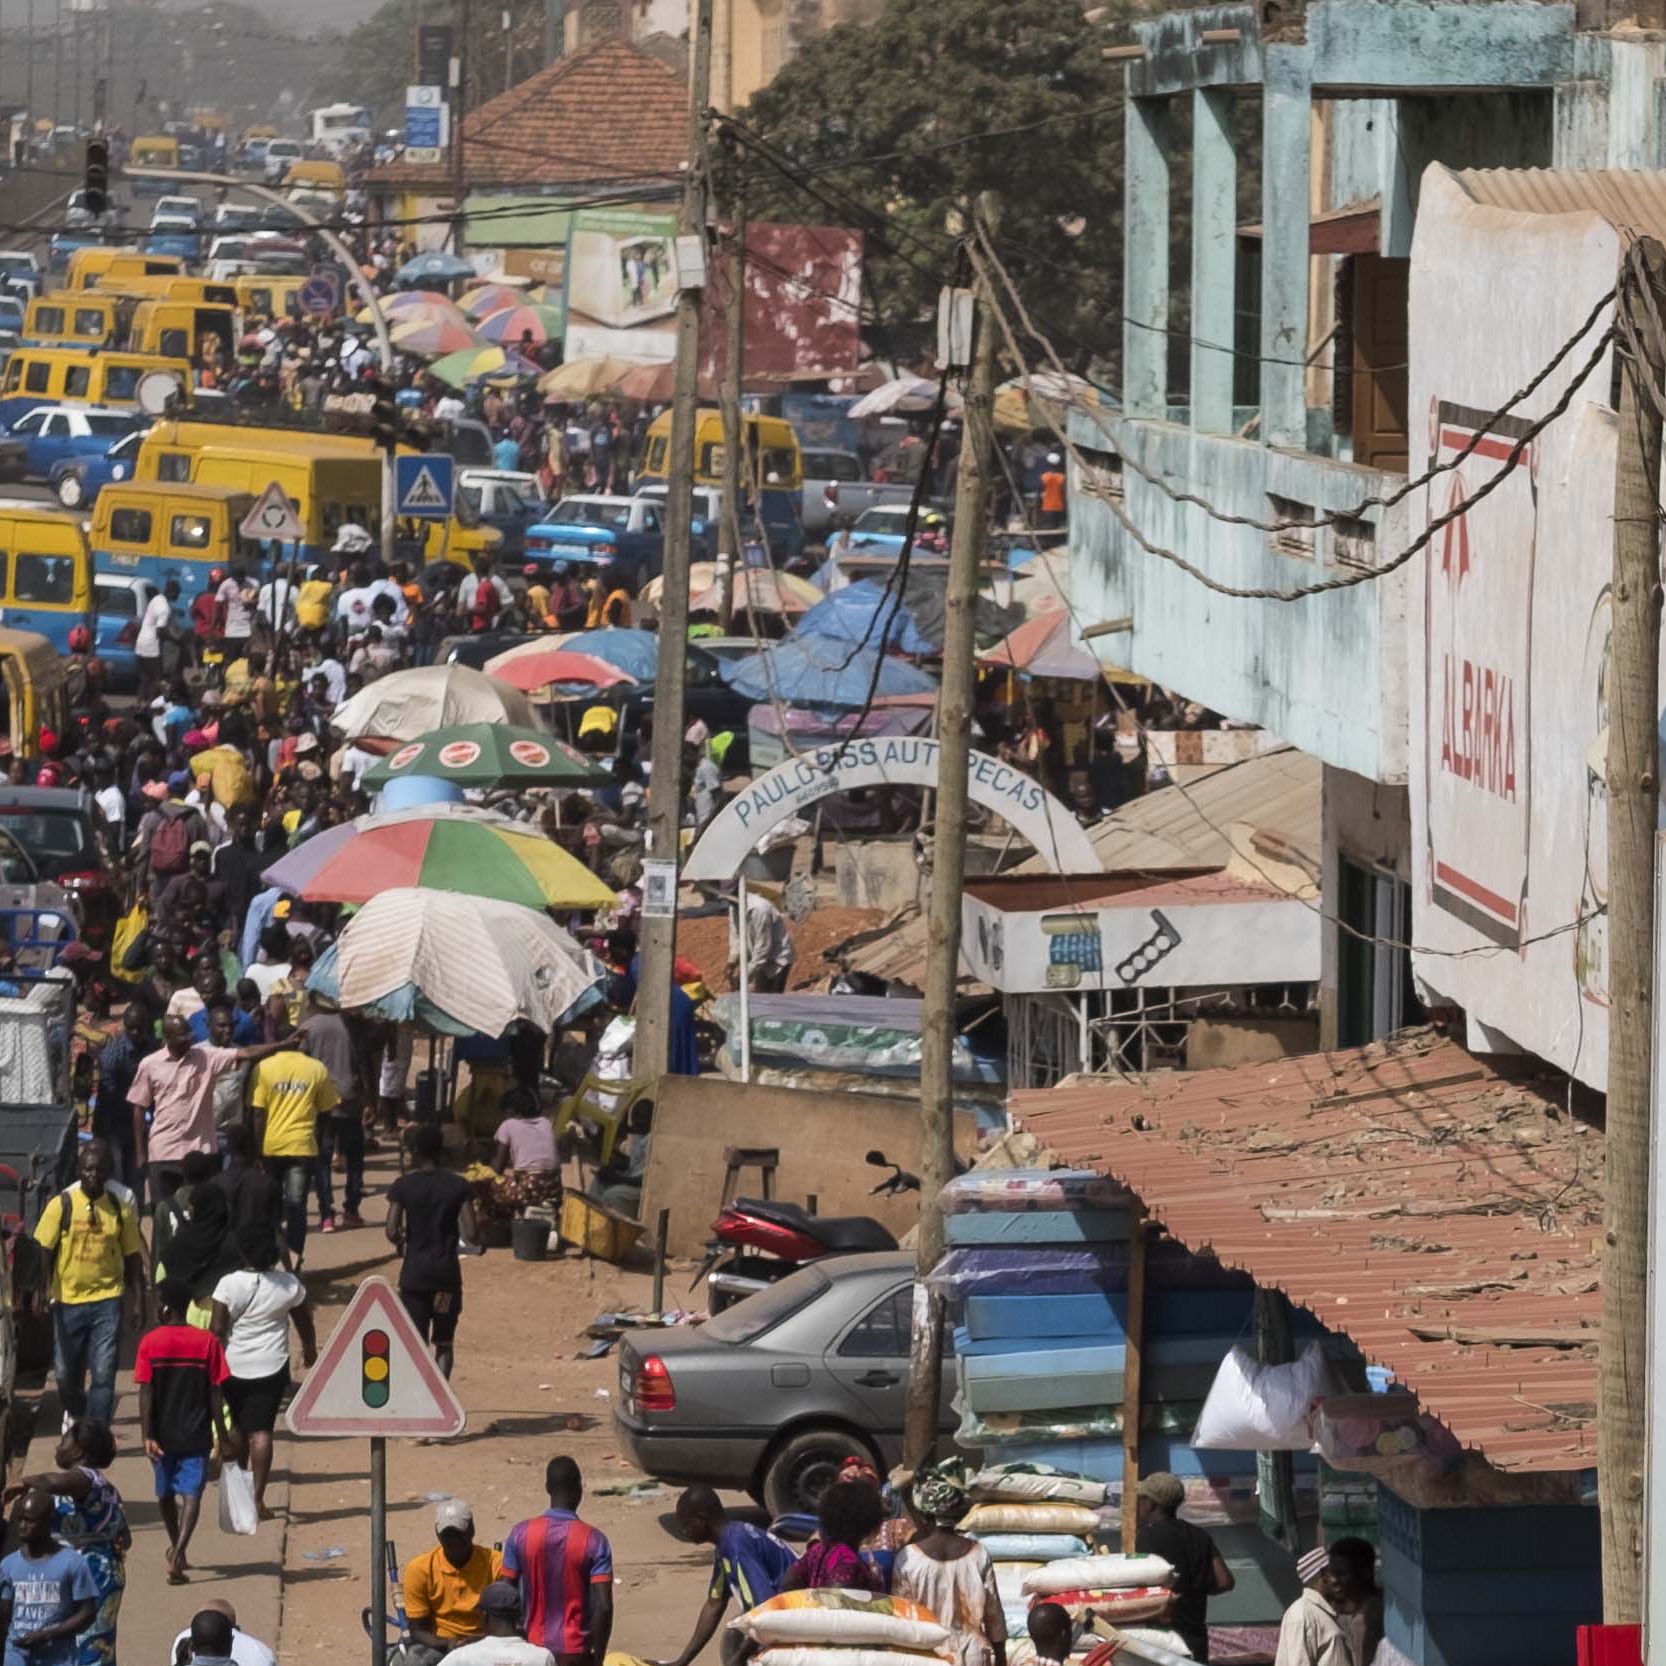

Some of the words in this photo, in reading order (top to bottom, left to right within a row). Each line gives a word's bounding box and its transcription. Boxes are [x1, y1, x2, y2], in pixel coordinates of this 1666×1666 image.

[735, 761, 815, 828] PAULO
[884, 742, 939, 766] AUT
[1441, 653, 1516, 805] ALBARKA
